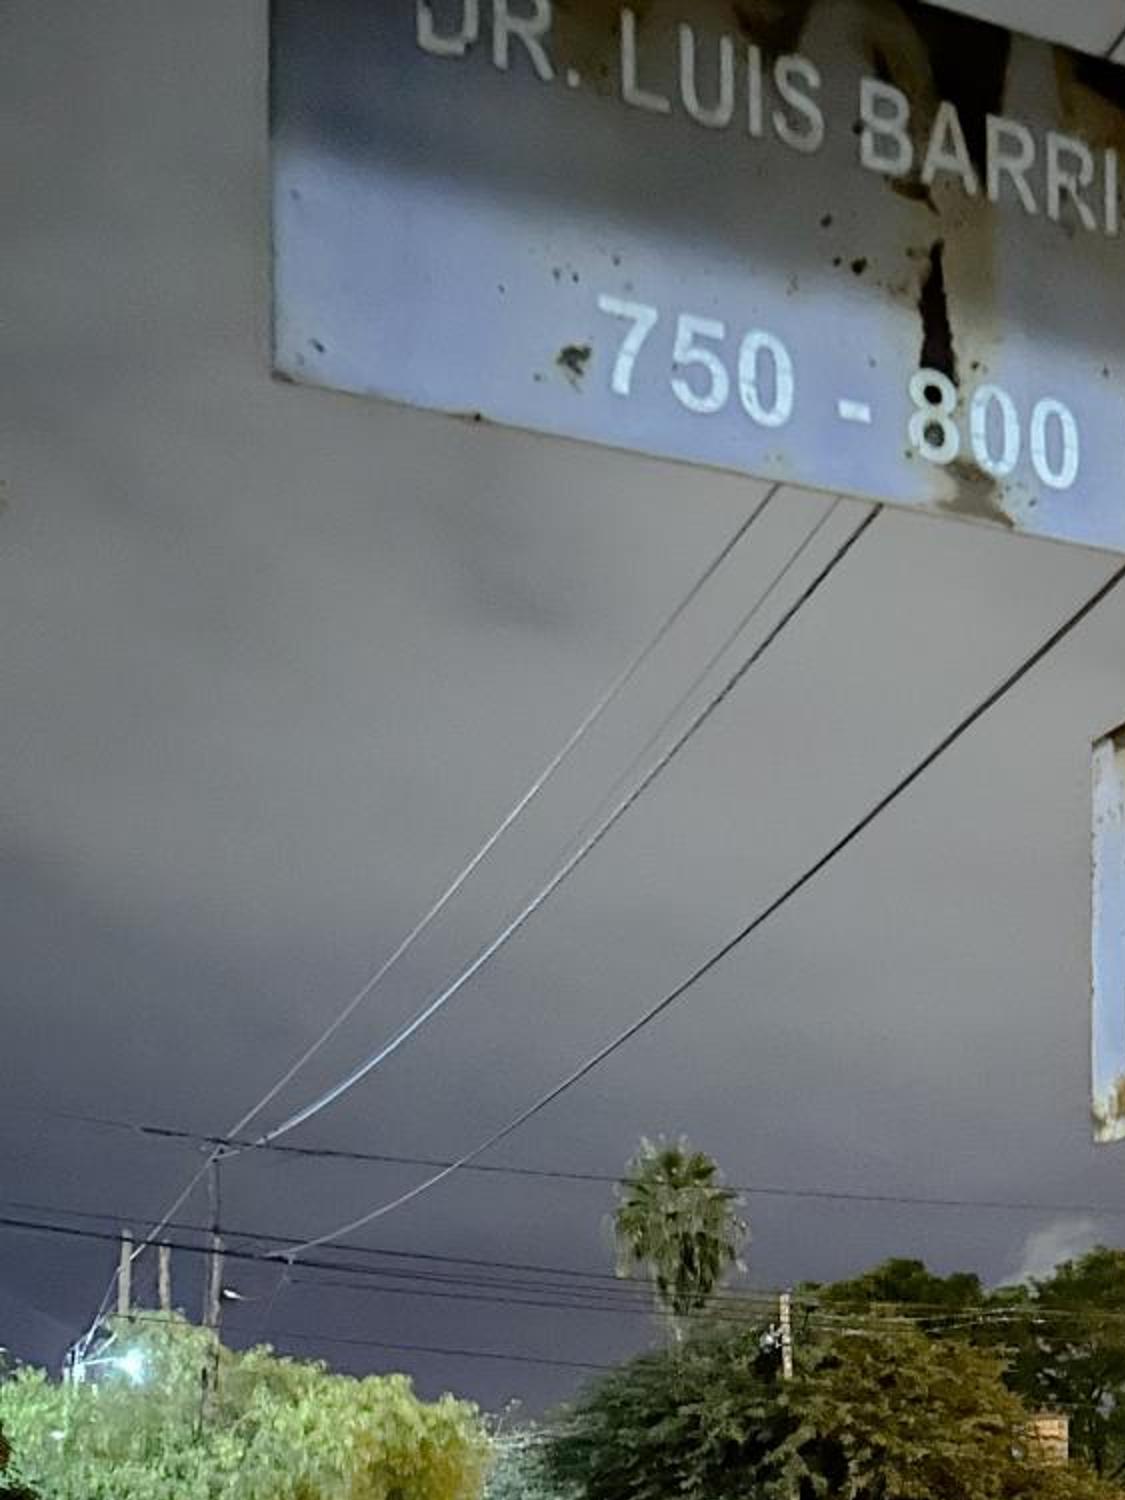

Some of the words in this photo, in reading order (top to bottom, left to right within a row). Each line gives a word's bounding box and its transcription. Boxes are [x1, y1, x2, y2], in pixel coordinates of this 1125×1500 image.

[620, 7, 827, 153] LUIS
[597, 292, 797, 430] 750
[838, 397, 872, 424] -
[907, 367, 1082, 490] 800
